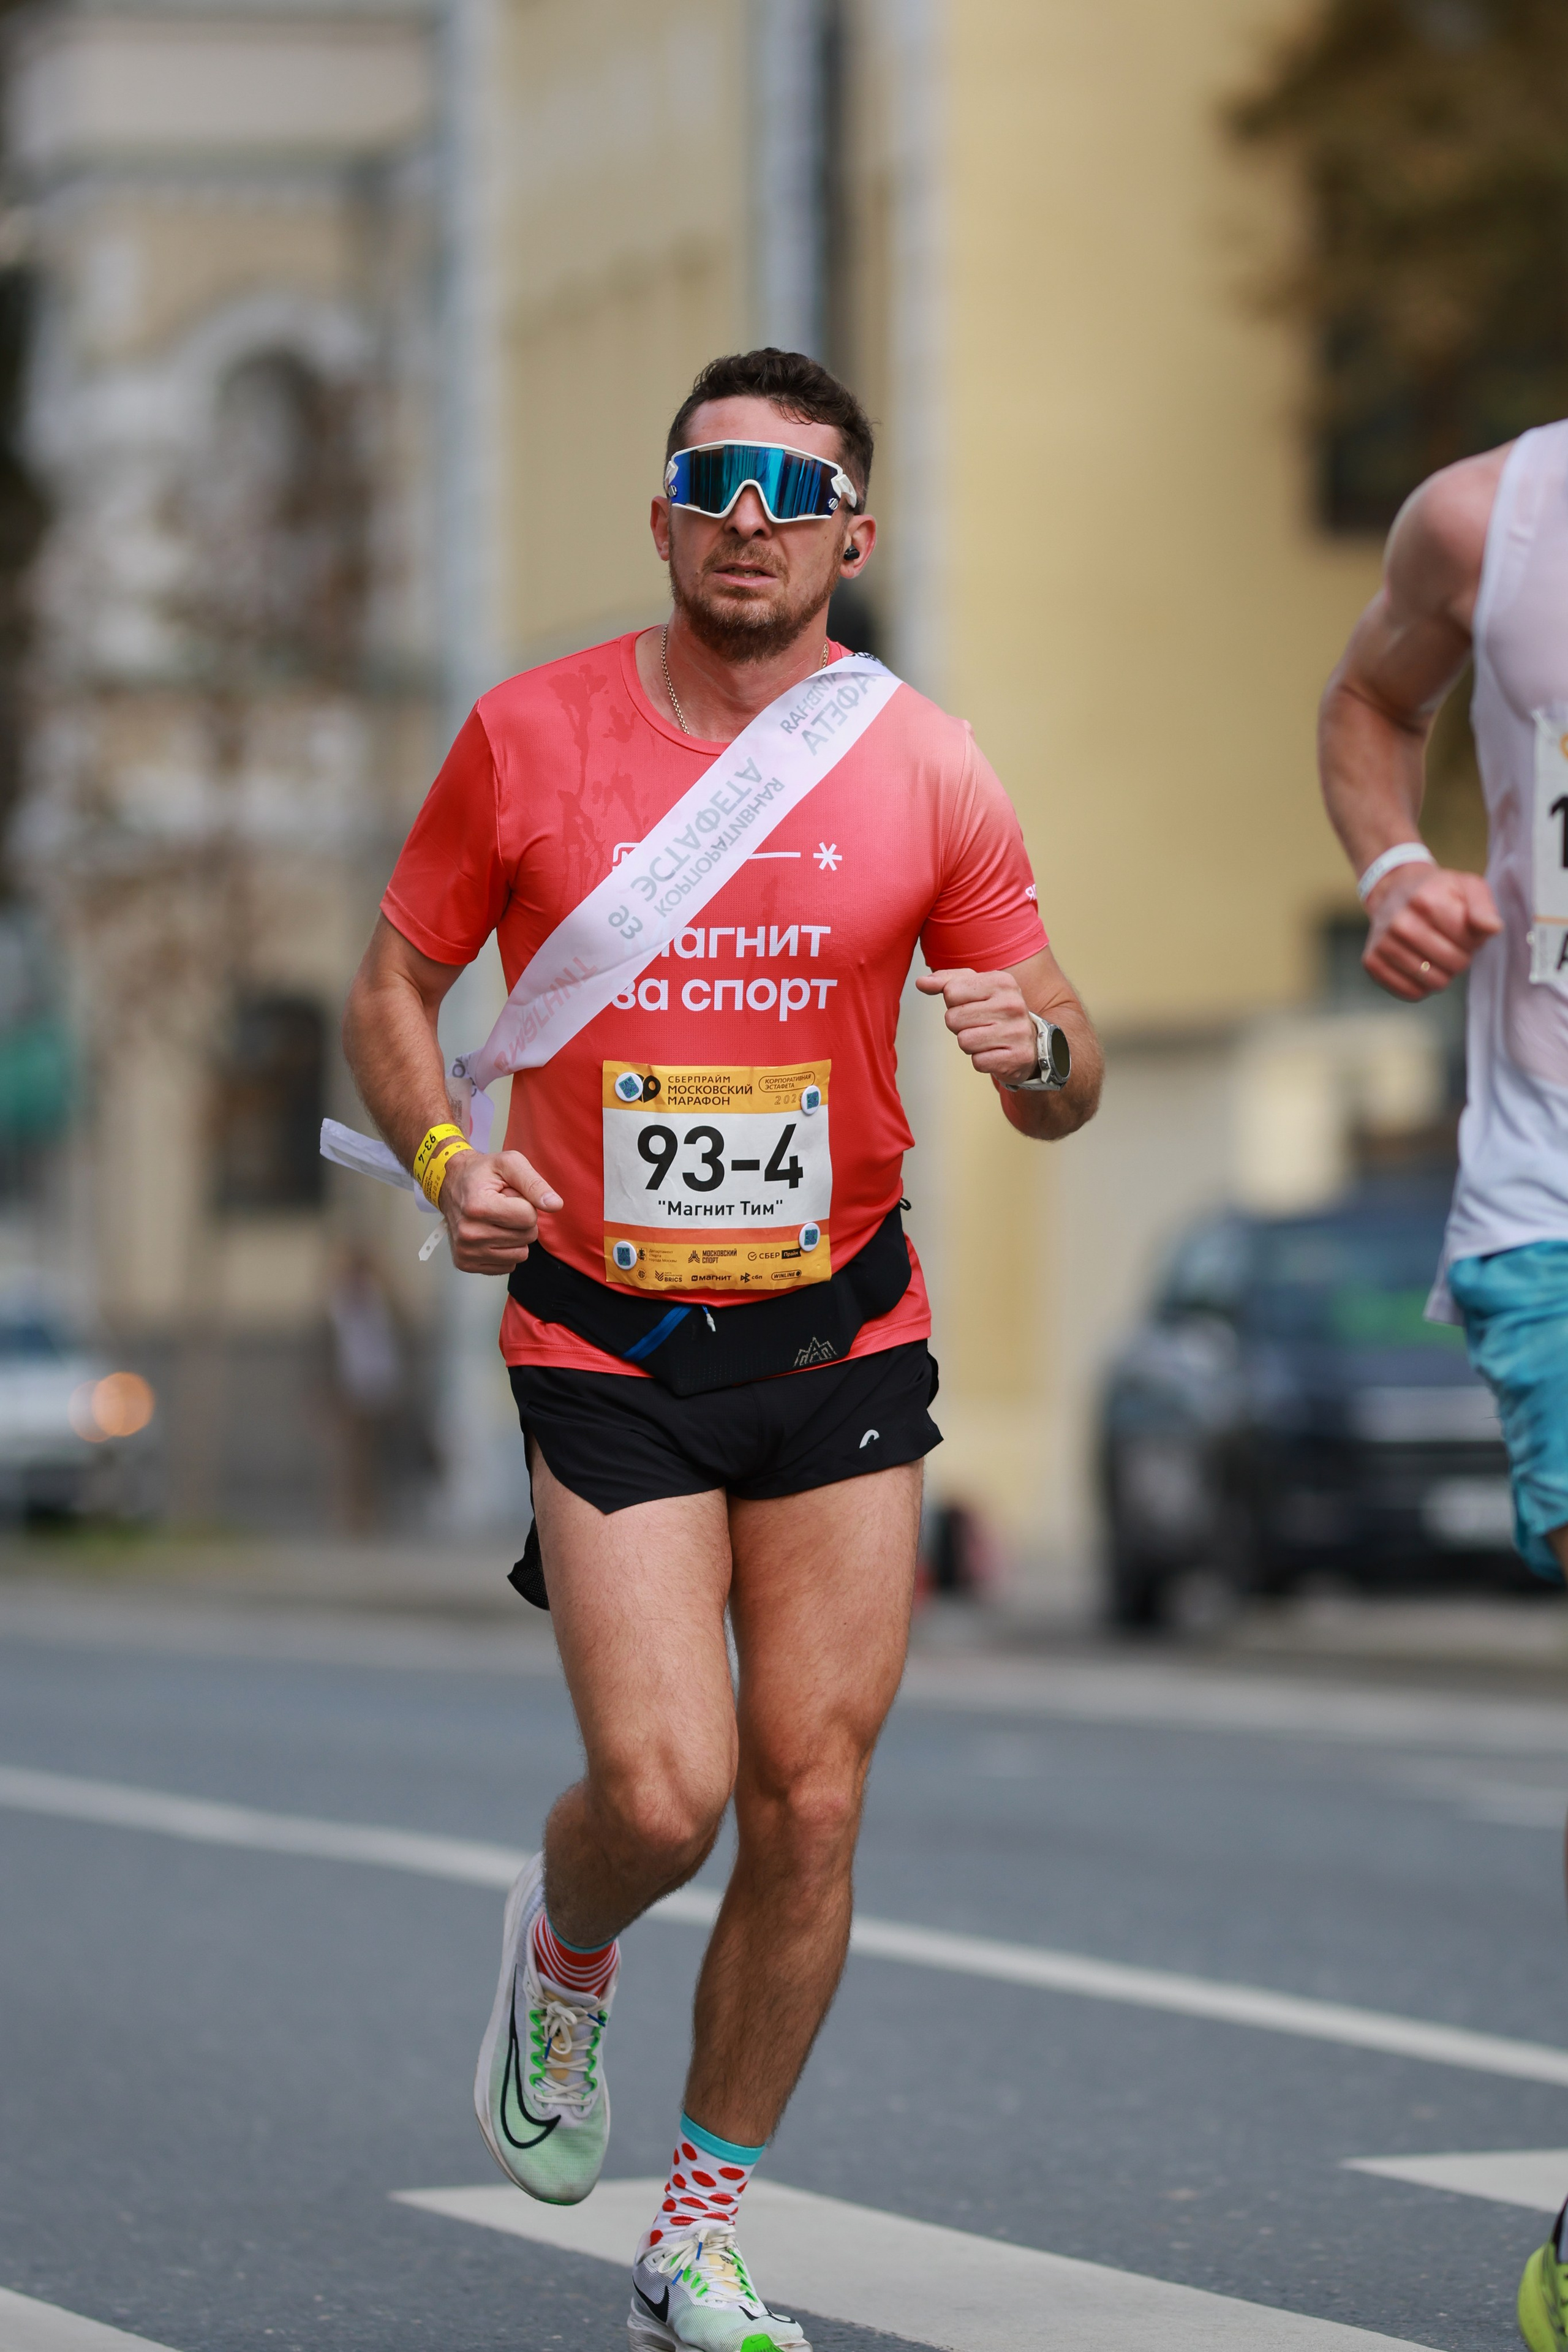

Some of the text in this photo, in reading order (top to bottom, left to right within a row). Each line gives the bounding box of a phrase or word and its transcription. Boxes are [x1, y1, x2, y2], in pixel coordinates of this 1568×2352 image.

[661, 925, 831, 959] агнит
[611, 978, 837, 1022] за спорт
[668, 1075, 731, 1084] СБЕРПРАЙМ
[764, 1074, 812, 1084] КОРПОРАТИВНАЯ
[668, 1084, 753, 1095] МОСКОВСКИЙ
[668, 1096, 730, 1105] МАРАФОН
[418, 1134, 436, 1164] 93-4
[637, 1123, 804, 1192] 93-4
[658, 1199, 783, 1216] "Магнит Тим"
